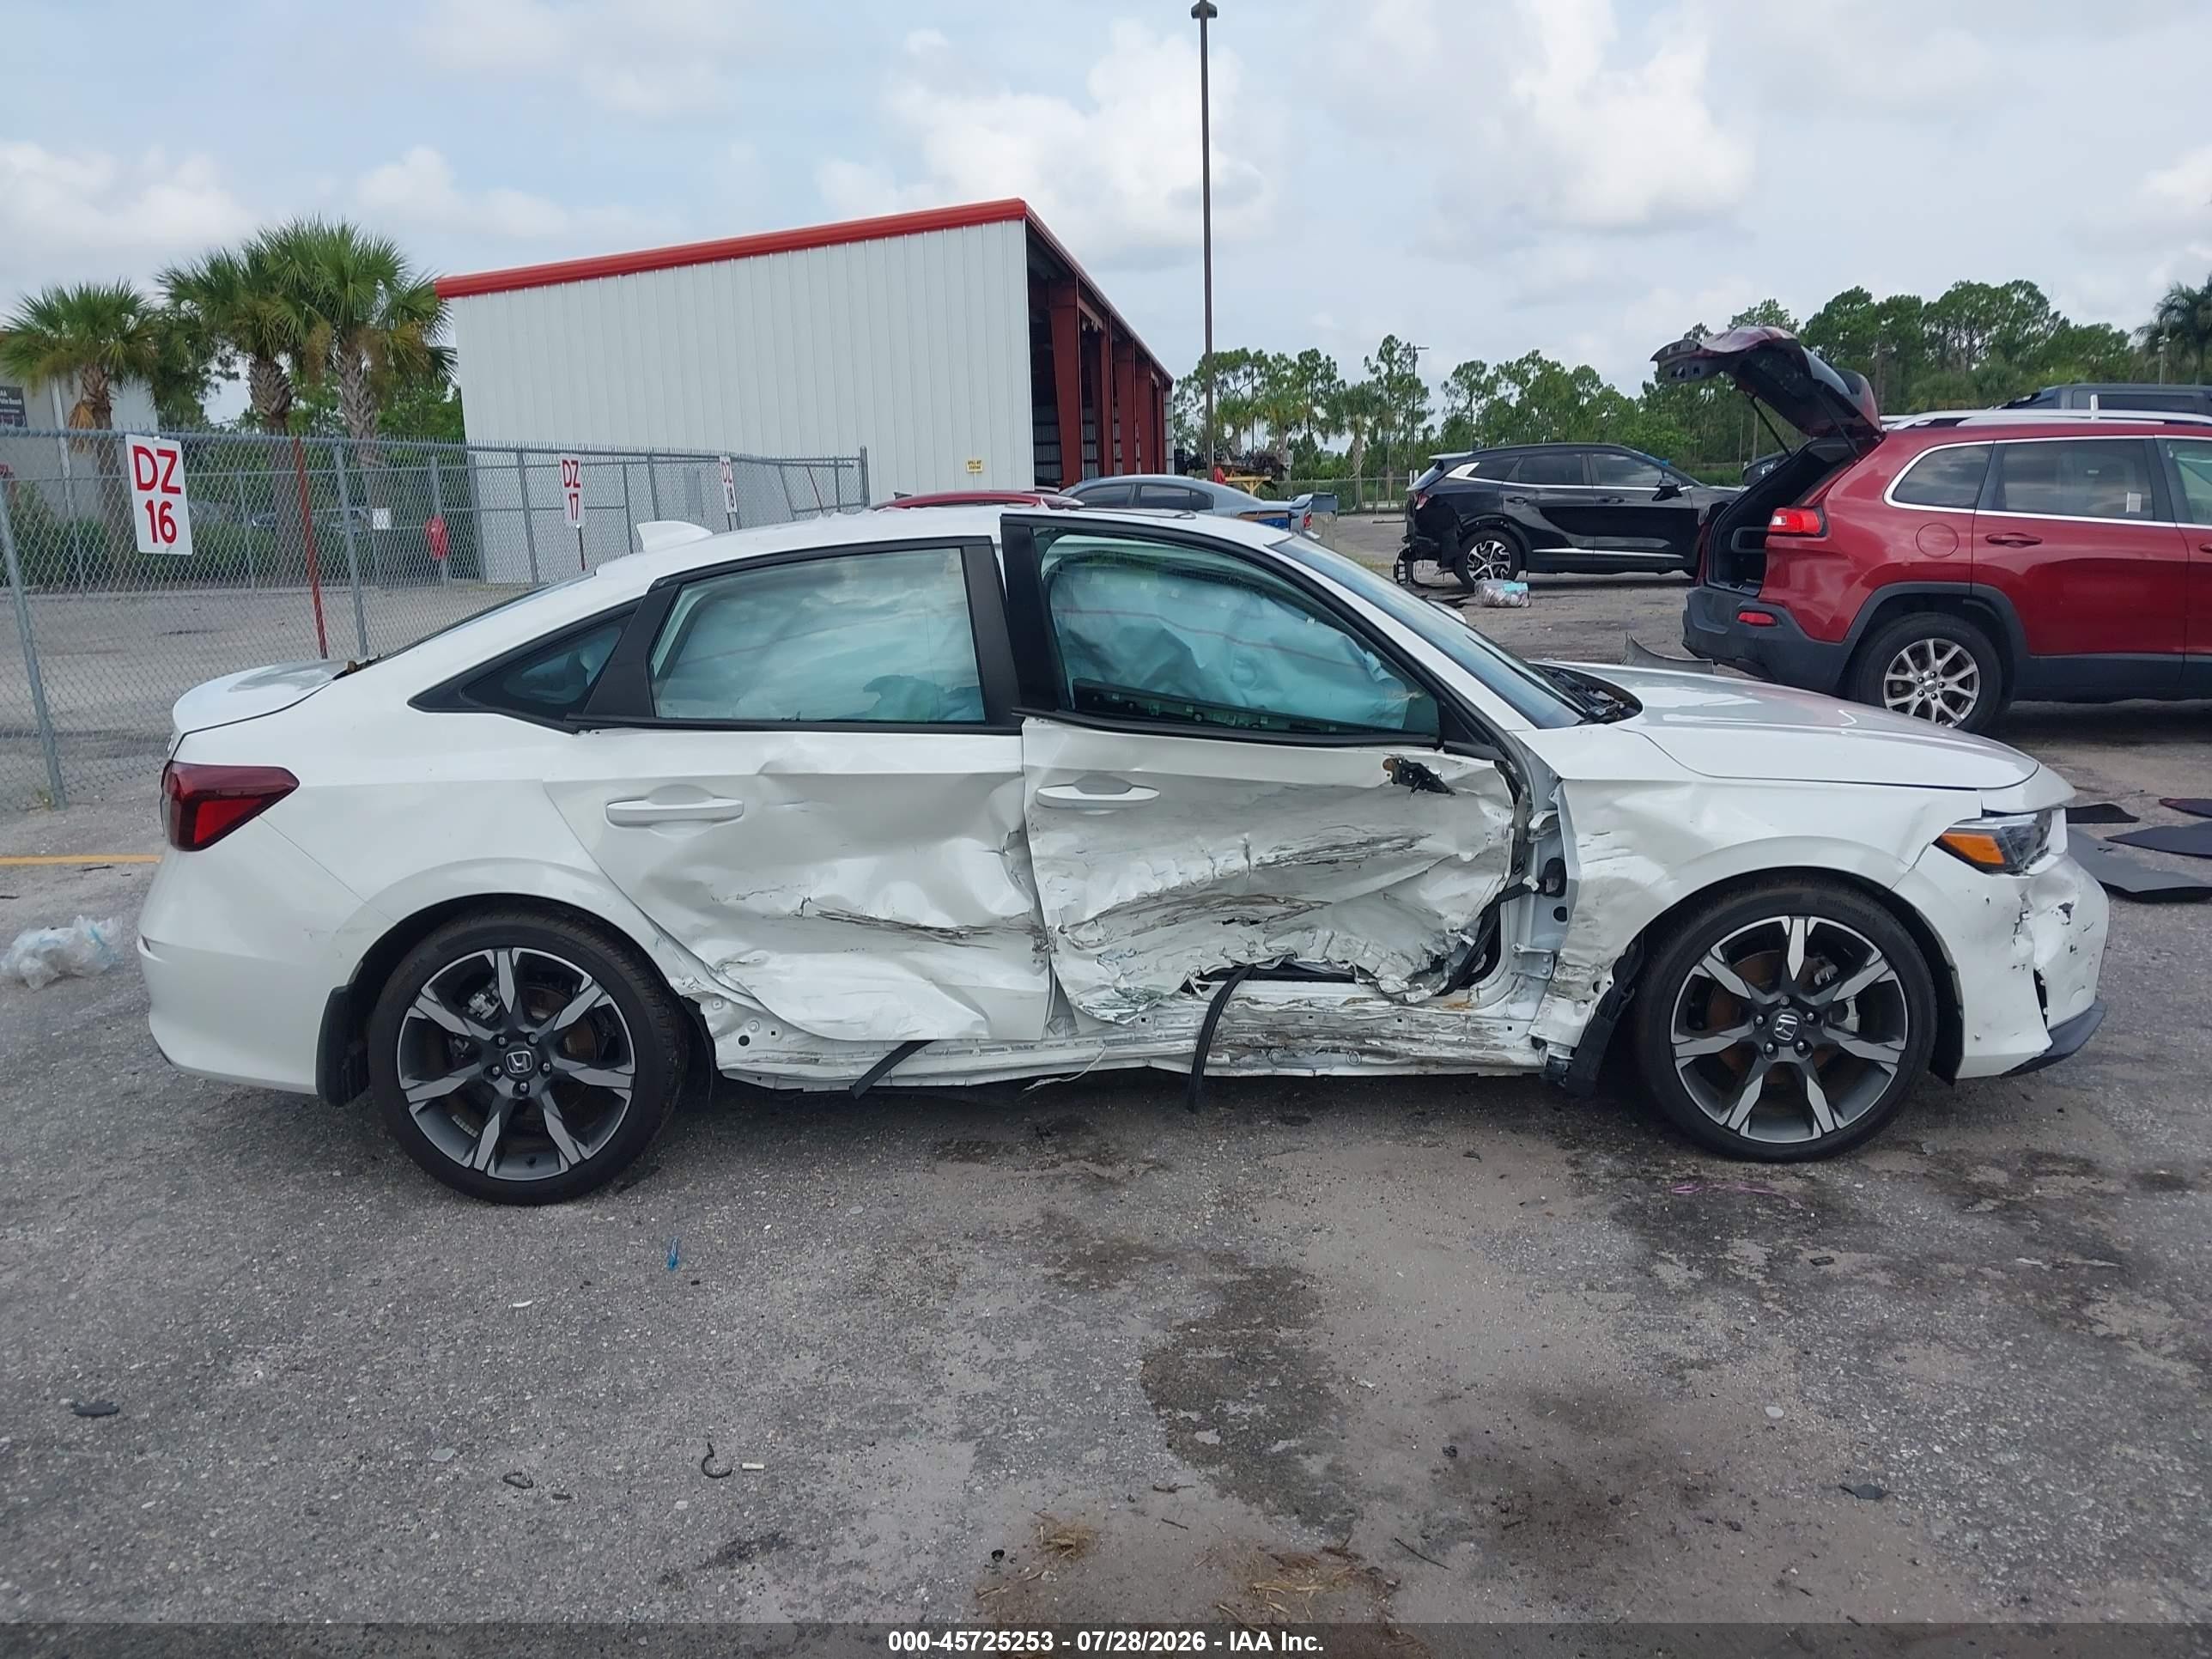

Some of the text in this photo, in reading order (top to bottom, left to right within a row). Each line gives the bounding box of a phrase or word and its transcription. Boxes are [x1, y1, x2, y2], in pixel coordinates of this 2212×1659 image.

[132, 444, 182, 495] DZ
[562, 459, 580, 488] DZ
[721, 460, 732, 483] DZ
[568, 493, 579, 521] 17
[726, 487, 735, 508] 18
[144, 500, 177, 544] 16
